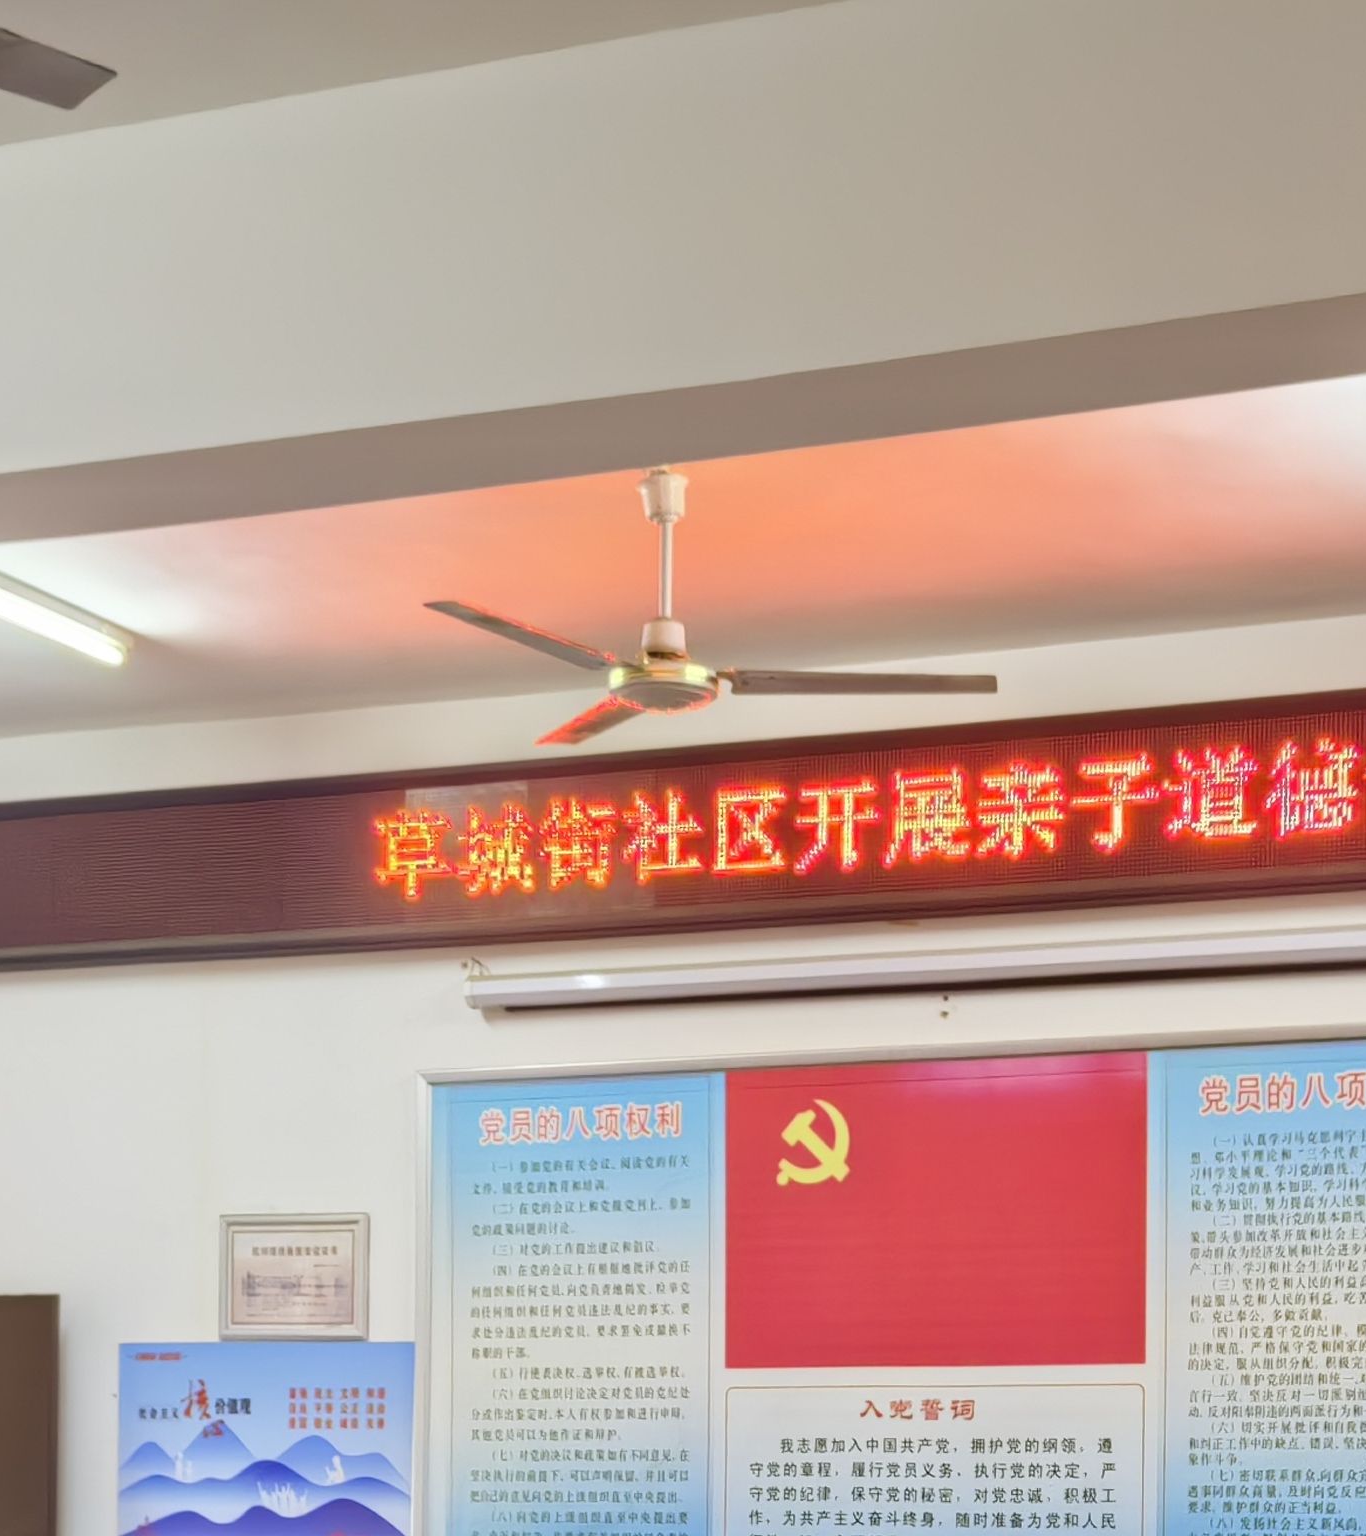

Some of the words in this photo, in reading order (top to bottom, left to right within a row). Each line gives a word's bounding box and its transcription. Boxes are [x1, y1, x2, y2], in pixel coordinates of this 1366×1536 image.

[480, 1102, 682, 1146] 党员的八项权利
[859, 1398, 977, 1421] 入党誓词
